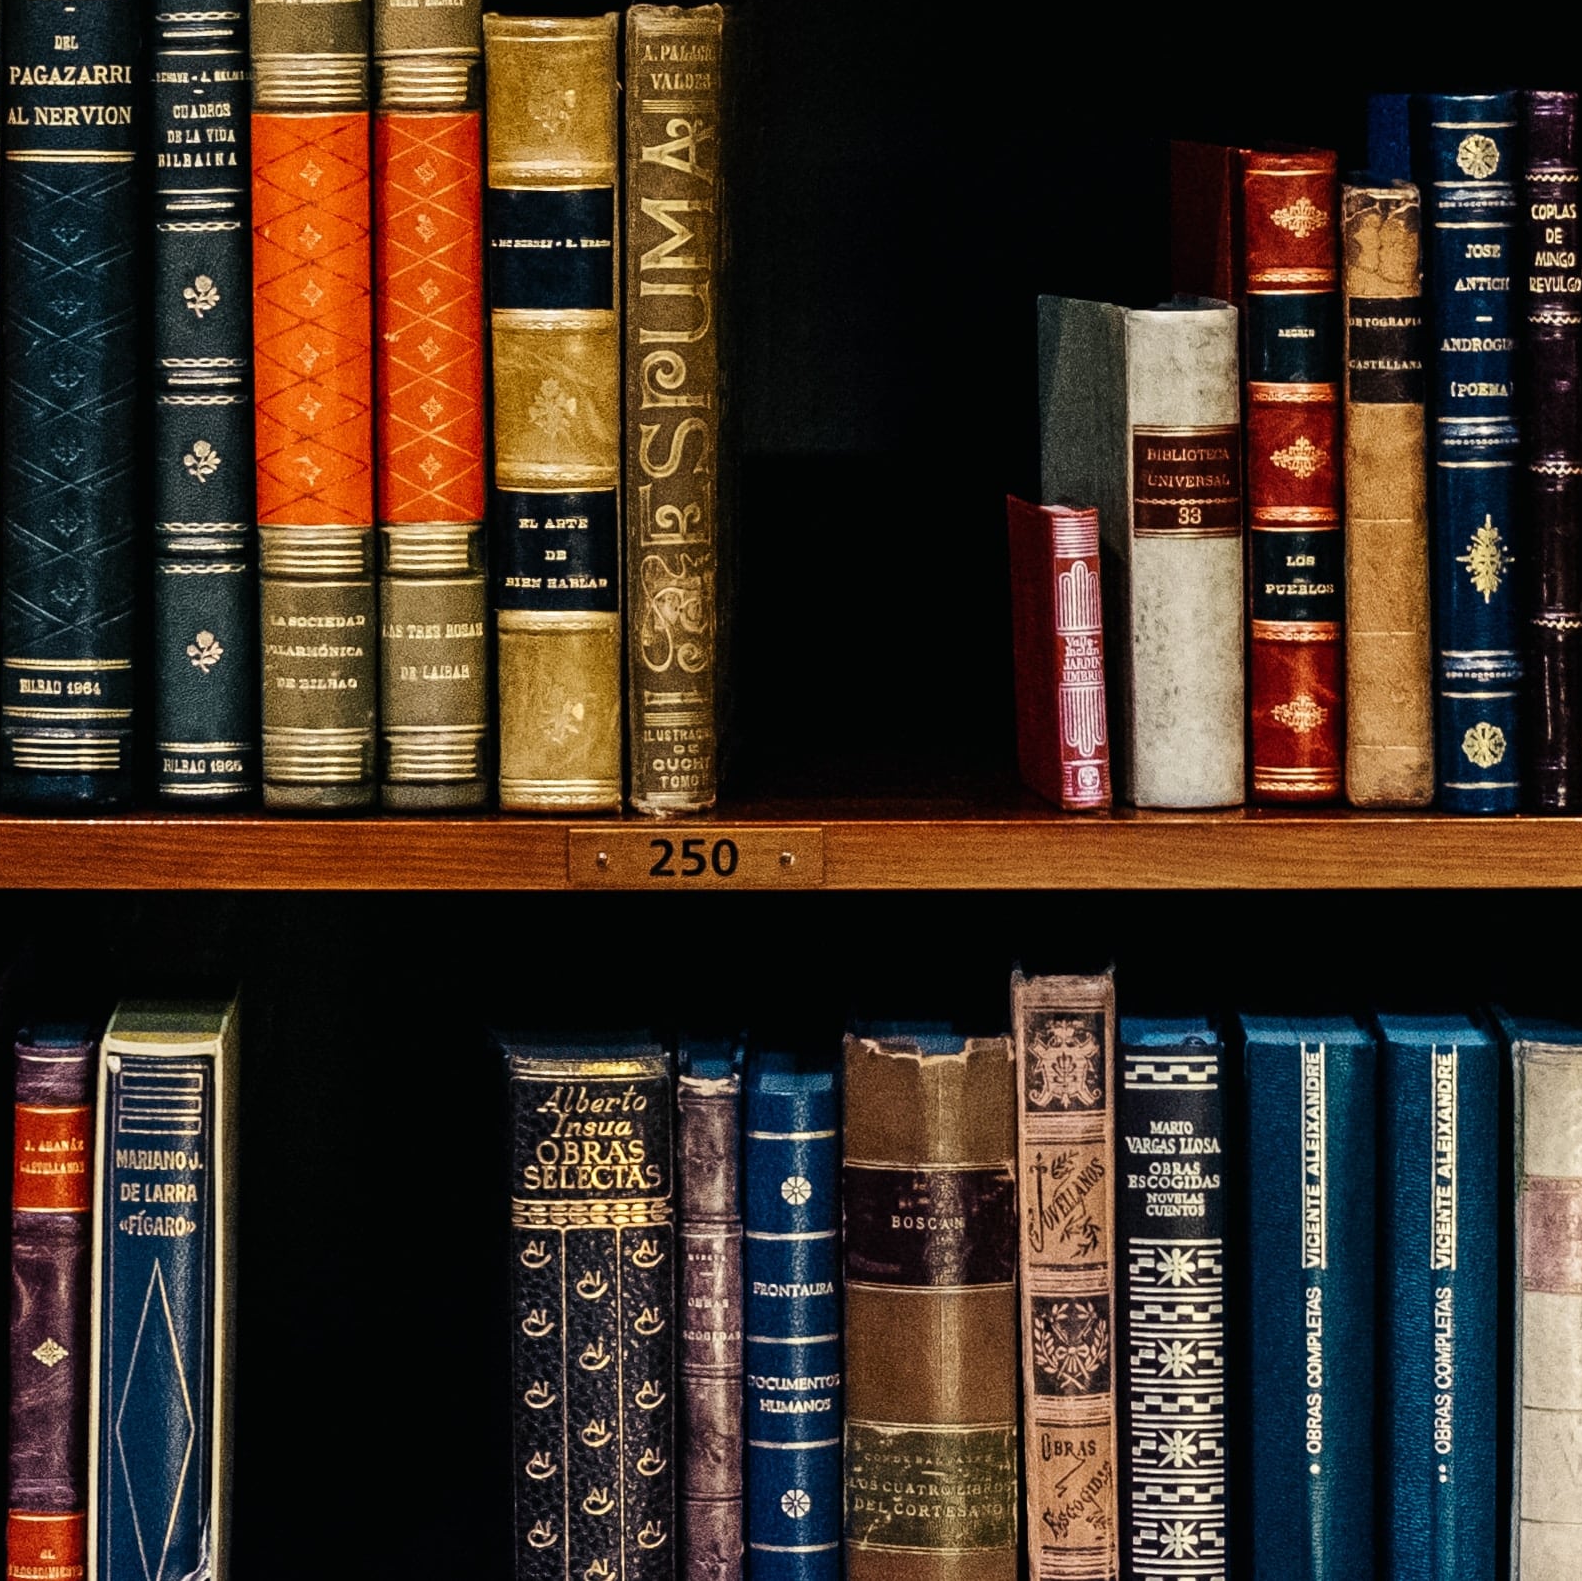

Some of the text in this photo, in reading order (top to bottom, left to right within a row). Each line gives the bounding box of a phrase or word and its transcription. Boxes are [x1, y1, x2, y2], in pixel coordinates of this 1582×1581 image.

[10, 66, 132, 87] PAGAZARRI
[8, 106, 132, 126] AL NERVION
[1531, 203, 1577, 221] COPLAS
[1545, 227, 1563, 245] DE
[1535, 251, 1575, 269] MINGO
[1529, 275, 1582, 293] REVULGO
[1147, 446, 1230, 464] BIBLIOTECA
[1148, 472, 1230, 489] UNIVERSAL
[1286, 554, 1315, 567] LOS
[1265, 582, 1335, 596] PUEBLOS
[649, 839, 739, 879] 250
[537, 1086, 648, 1114] Alberto
[551, 1115, 633, 1138] Insua
[1150, 1121, 1193, 1136] MARIO
[116, 1151, 203, 1171] MARIANO J.
[536, 1140, 645, 1166] OBRAS
[1305, 1052, 1321, 1269] VICENTE ALEIXANDRE
[524, 1164, 661, 1190] SELECTAS
[1149, 1161, 1200, 1176] OBRAS
[1127, 1173, 1220, 1190] ESCOGIDAS
[120, 1182, 197, 1203] DE LARRA
[1306, 1286, 1323, 1455] OBRAS COMPLETAS
